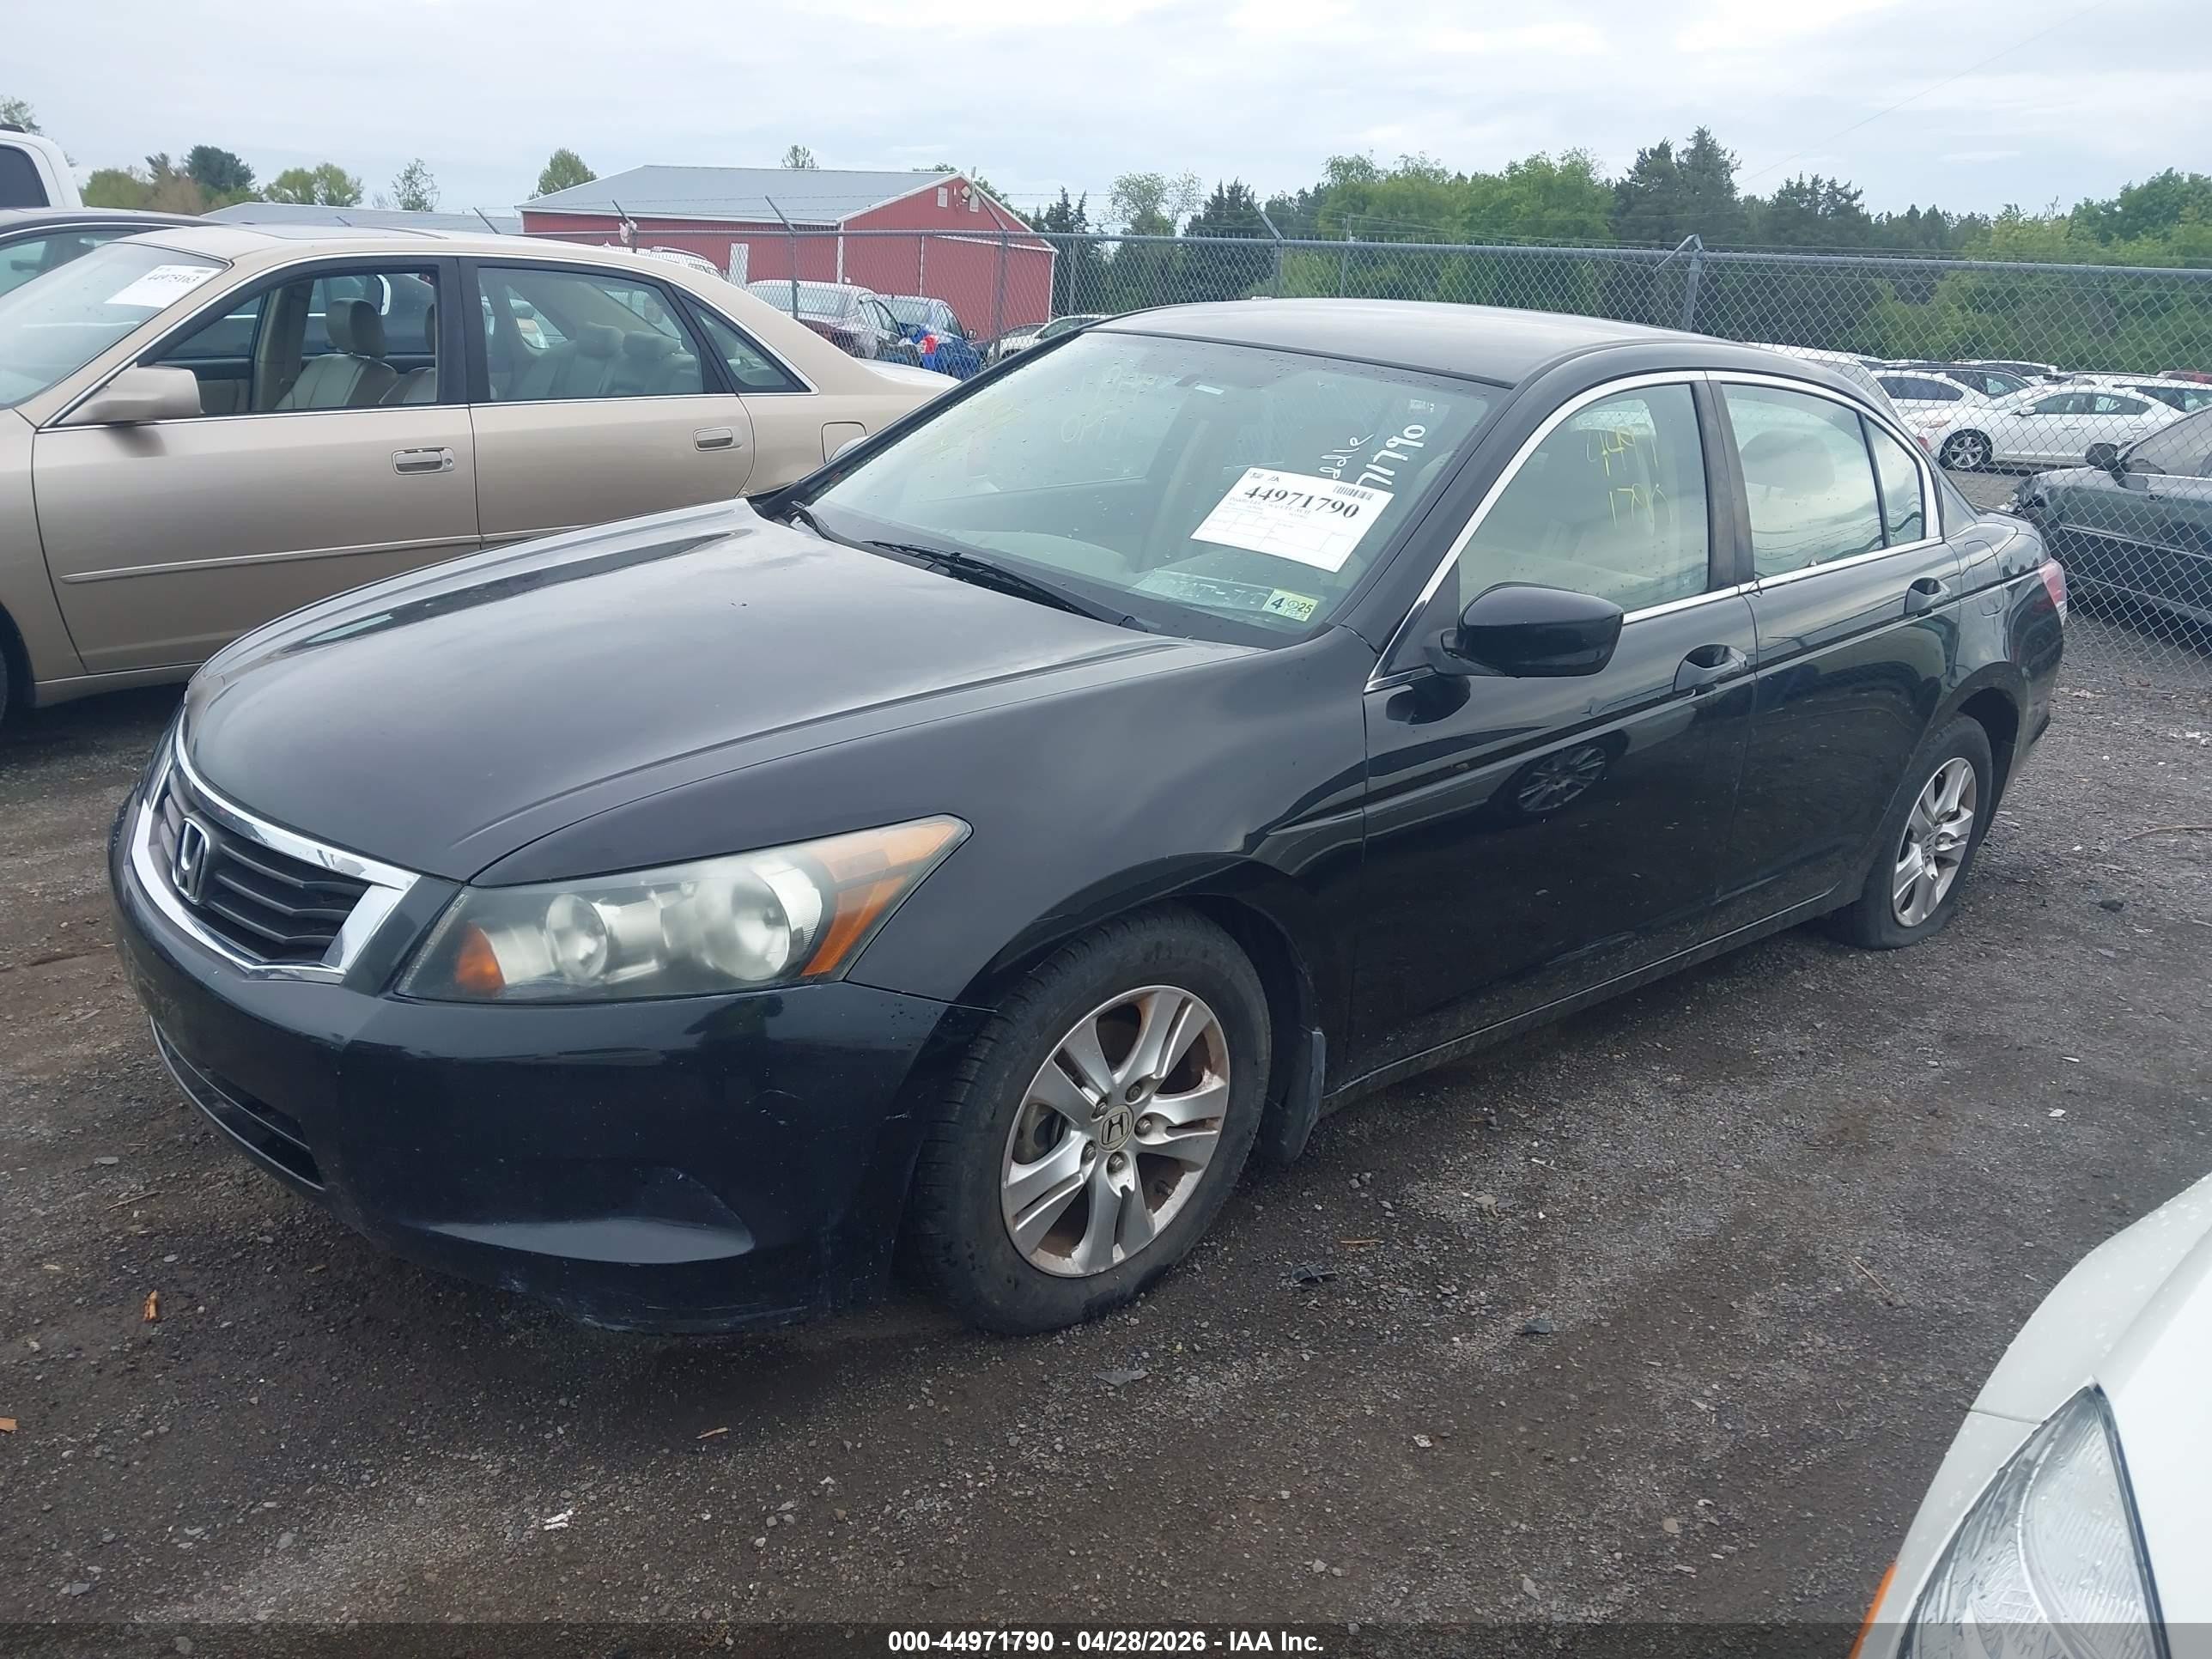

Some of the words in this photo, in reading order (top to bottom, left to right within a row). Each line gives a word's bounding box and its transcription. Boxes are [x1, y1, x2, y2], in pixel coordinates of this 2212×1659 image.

[1243, 485, 1360, 519] 44971790
[1271, 597, 1285, 610] 4
[1297, 602, 1314, 614] 25
